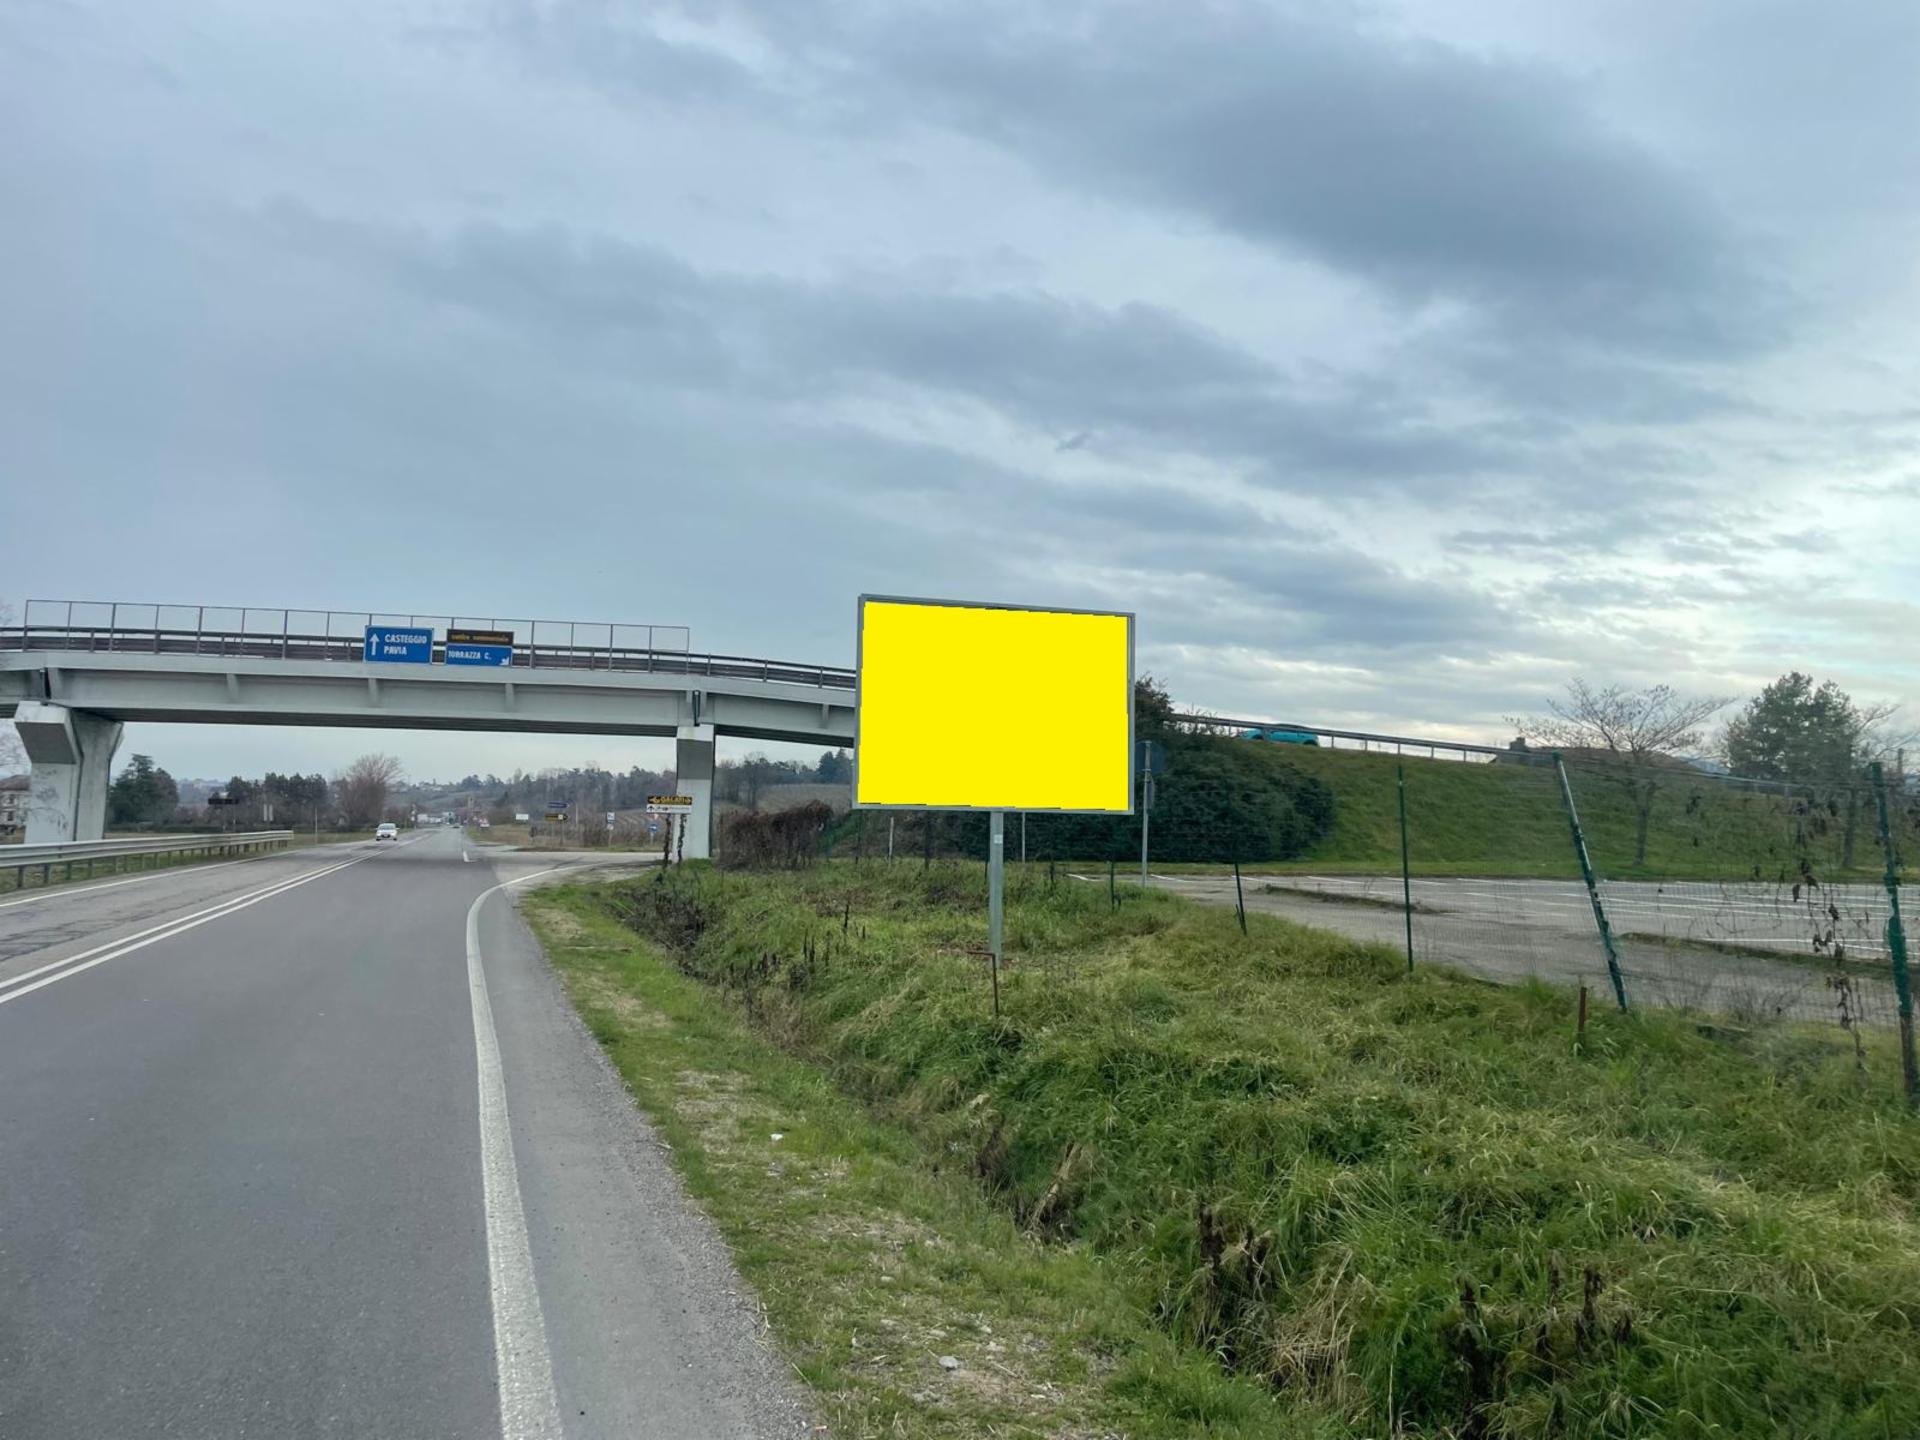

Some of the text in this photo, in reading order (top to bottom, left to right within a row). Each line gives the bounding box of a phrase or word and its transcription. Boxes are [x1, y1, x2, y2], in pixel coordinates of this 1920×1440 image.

[384, 634, 428, 644] CASTEGGIO
[383, 645, 408, 655] PAVIA
[448, 650, 481, 659] TORRAZZA
